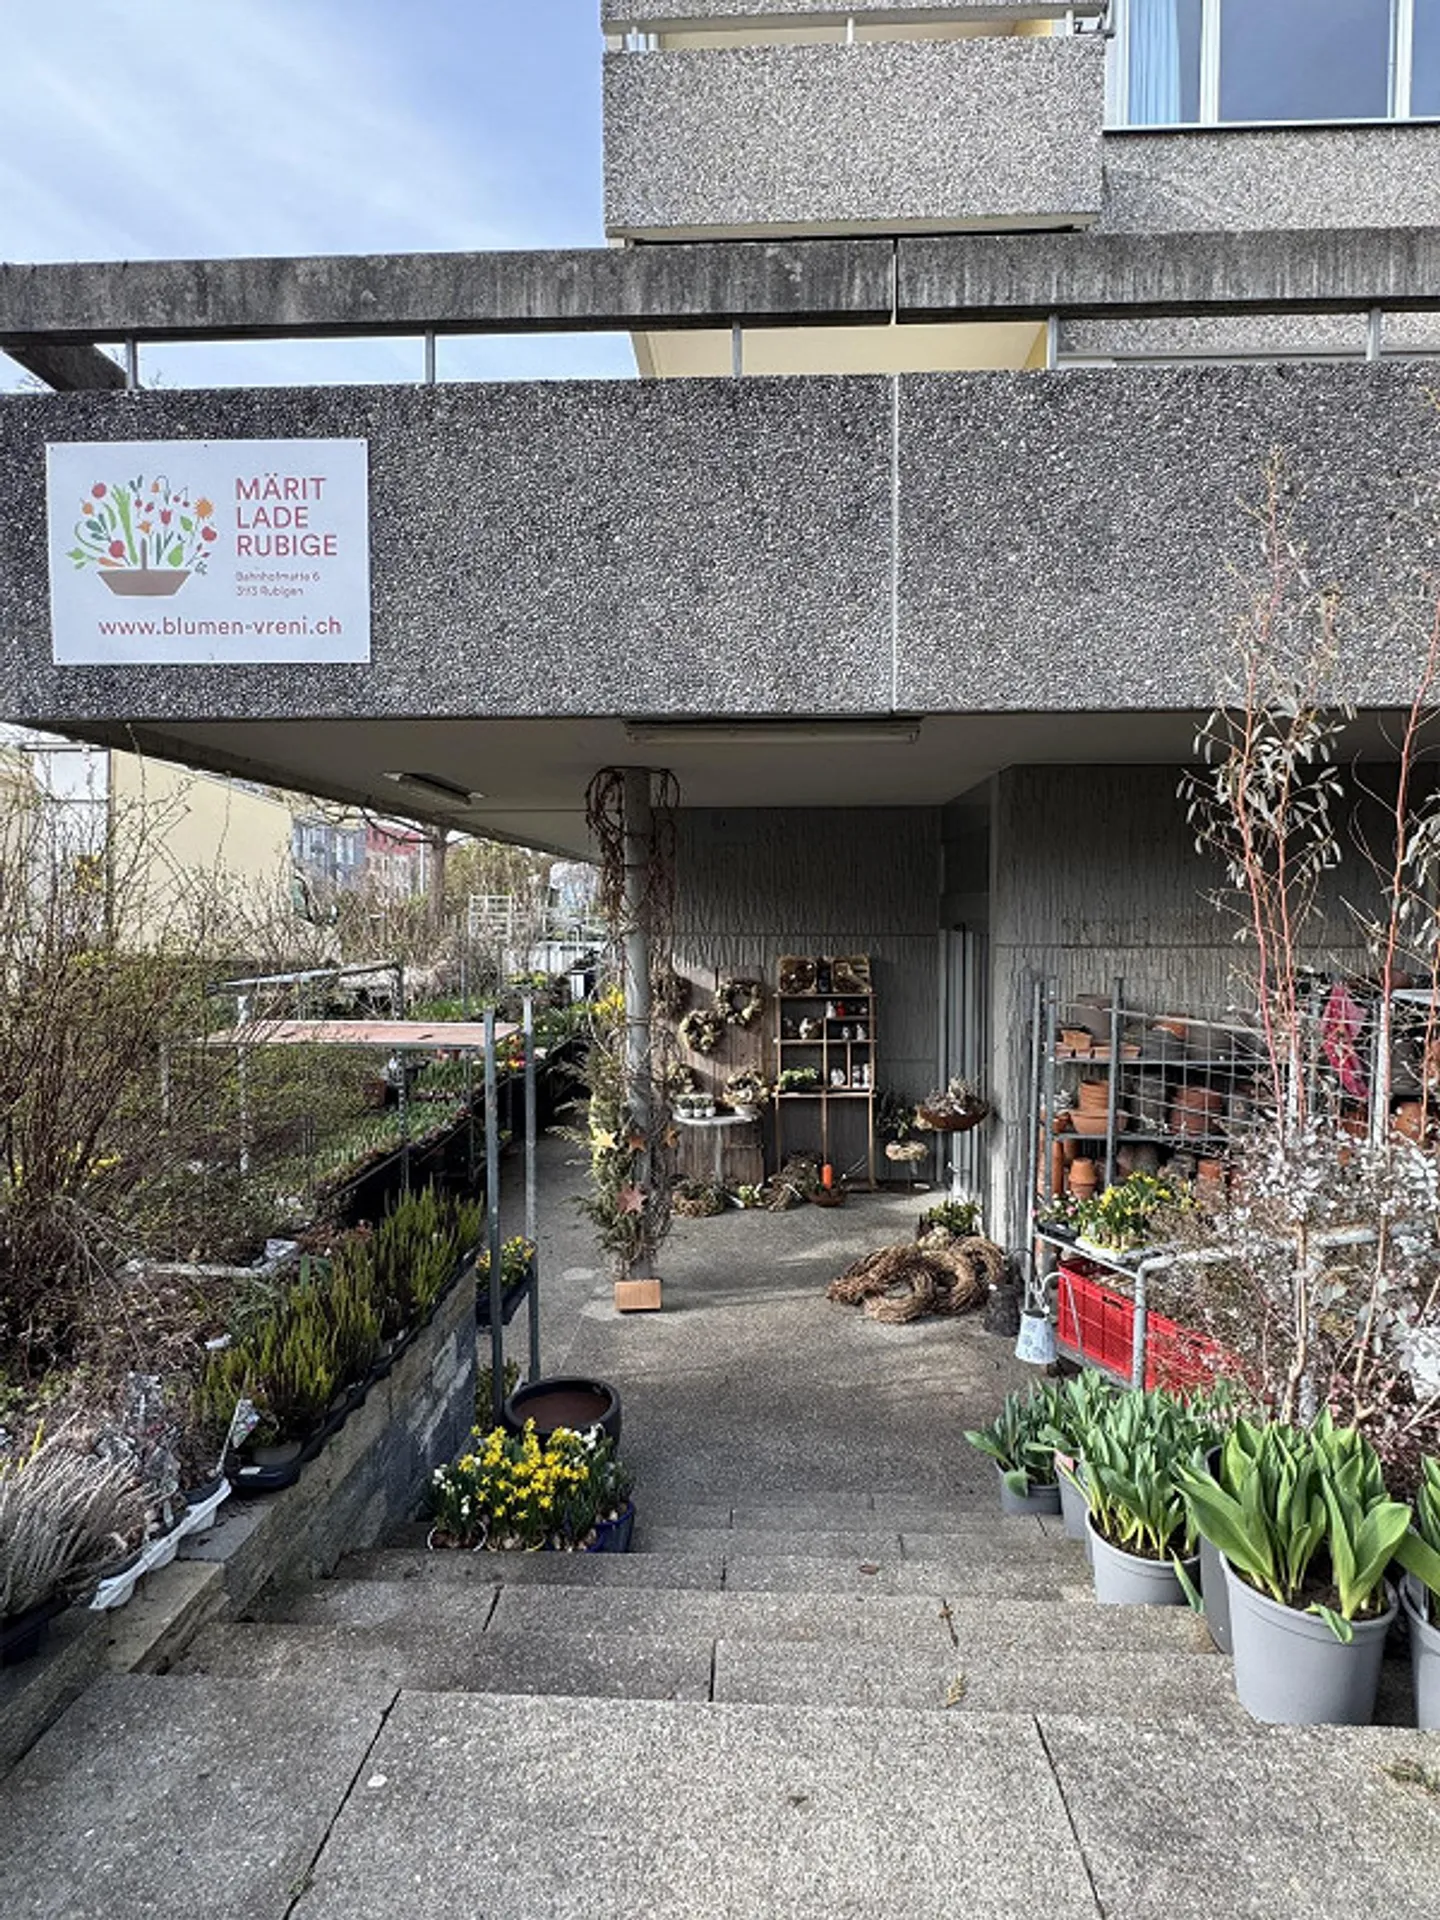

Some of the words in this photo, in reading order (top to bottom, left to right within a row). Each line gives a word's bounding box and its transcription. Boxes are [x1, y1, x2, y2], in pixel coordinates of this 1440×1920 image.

[235, 473, 326, 500] MÄRIT
[236, 507, 308, 528] LADE
[236, 534, 337, 556] RUBIGE
[260, 585, 304, 598] Rubigen
[98, 616, 342, 636] www.blumen-vreni.ch
